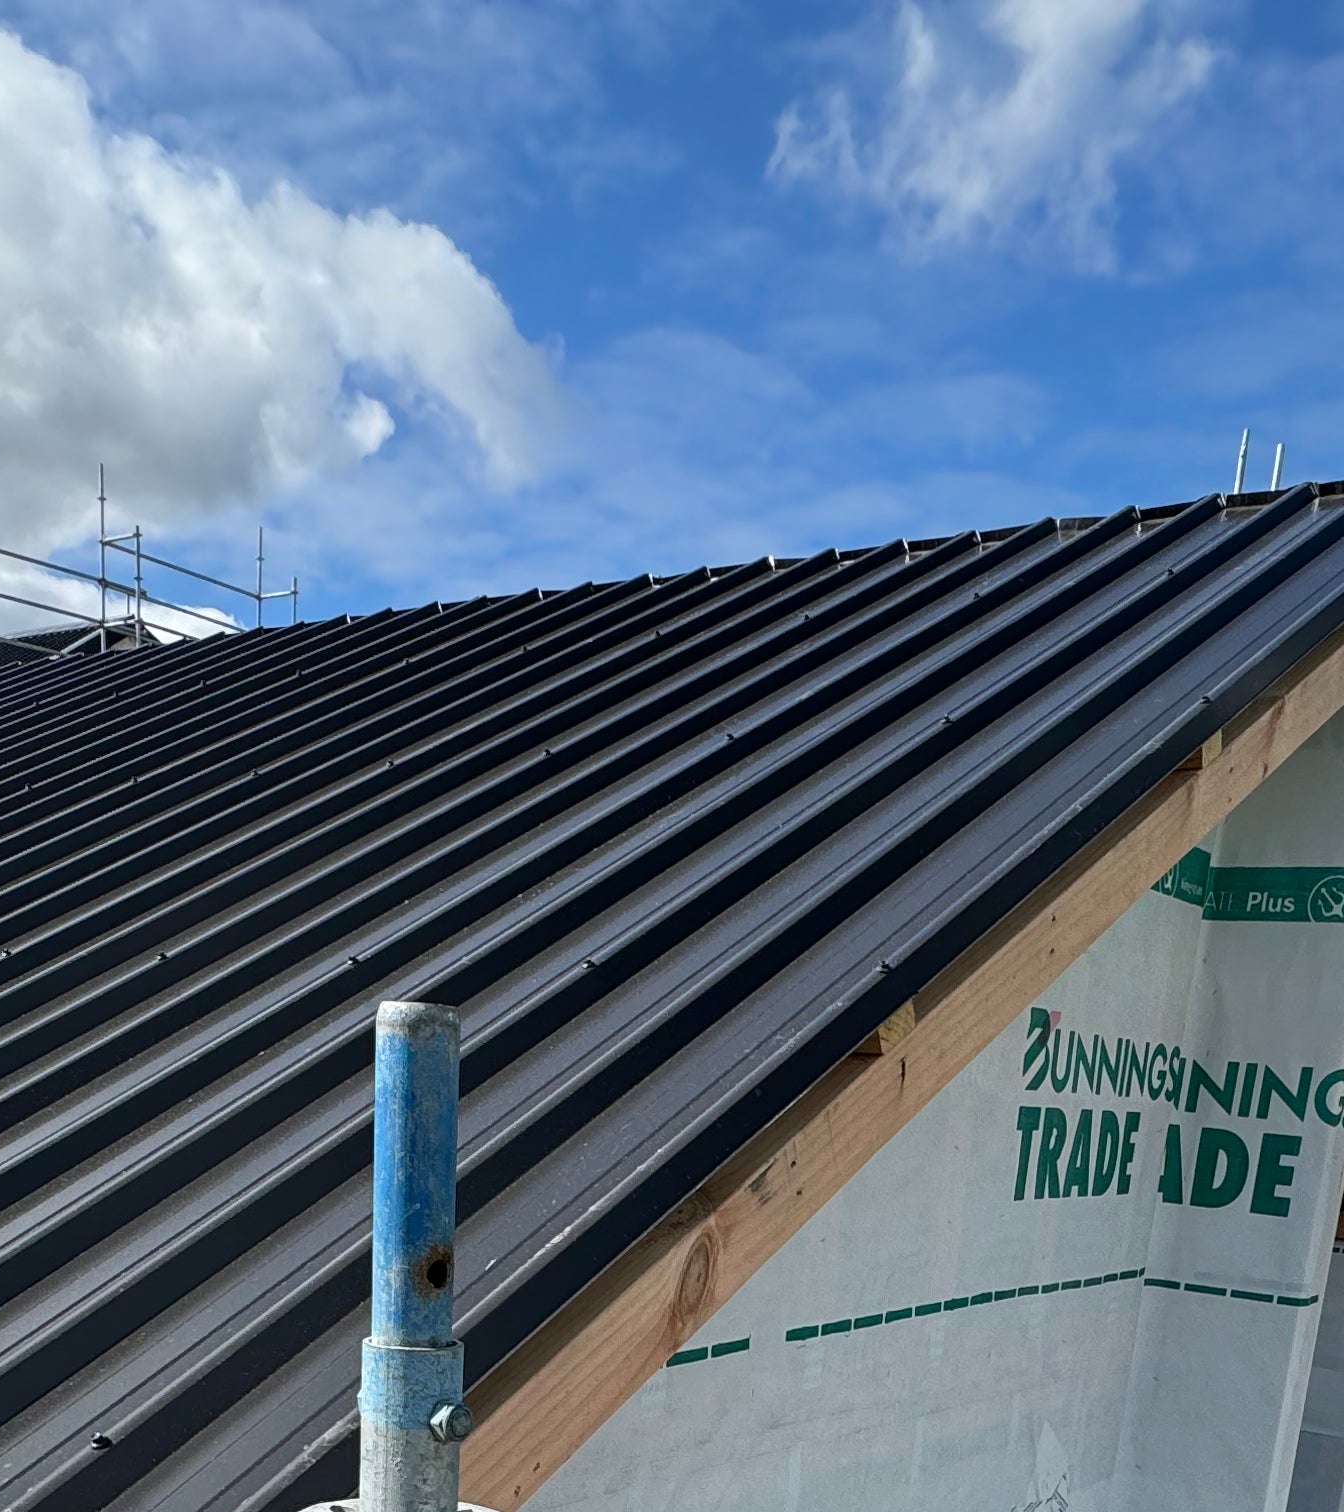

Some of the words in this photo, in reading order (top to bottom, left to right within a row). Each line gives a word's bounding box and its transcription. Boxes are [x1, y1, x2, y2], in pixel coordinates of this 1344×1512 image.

[1245, 890, 1296, 914] Plus
[1022, 1006, 1181, 1103] BUNNINGS
[1013, 1105, 1142, 1202] TRADE
